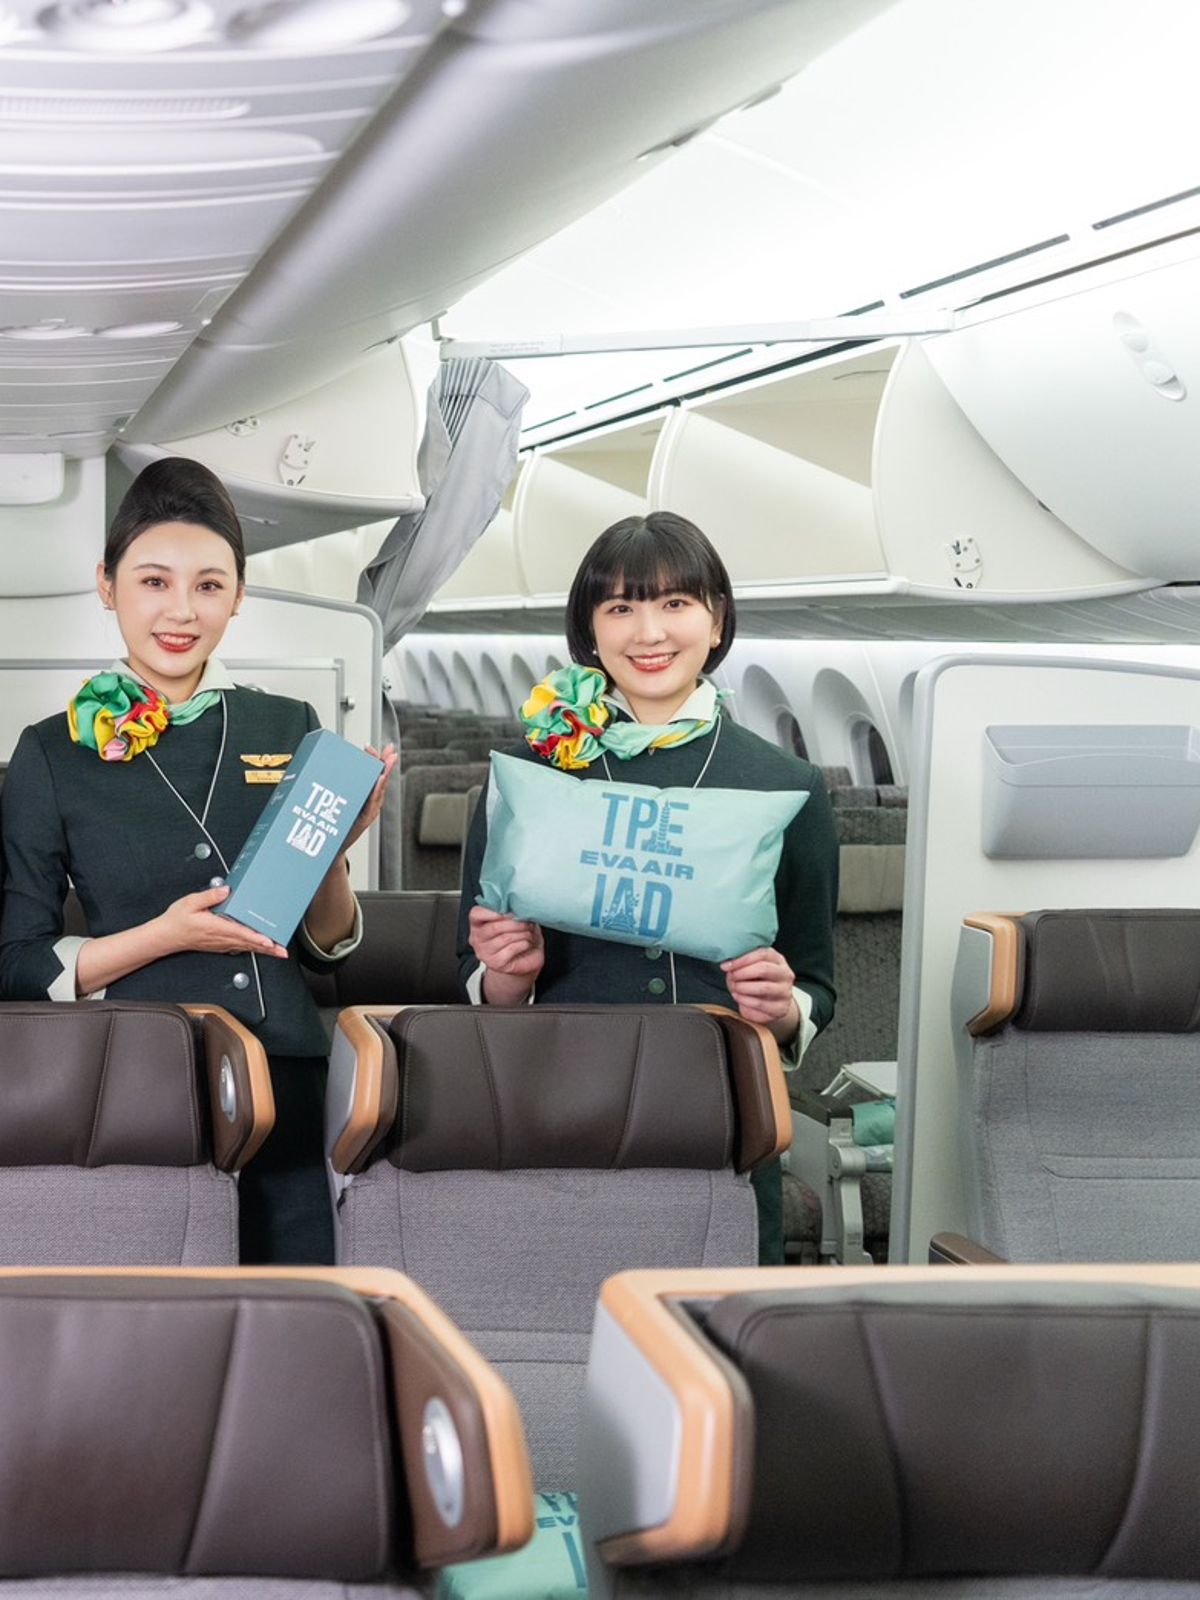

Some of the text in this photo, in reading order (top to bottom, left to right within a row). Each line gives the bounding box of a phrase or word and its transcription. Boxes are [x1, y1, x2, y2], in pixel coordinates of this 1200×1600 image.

[292, 805, 338, 836] EVA AIR
[305, 782, 348, 824] TPE
[286, 818, 327, 857] IAD
[602, 792, 689, 856] TPE
[580, 850, 694, 880] EVA AIR
[590, 873, 672, 938] IAD
[536, 1515, 576, 1529] EV
